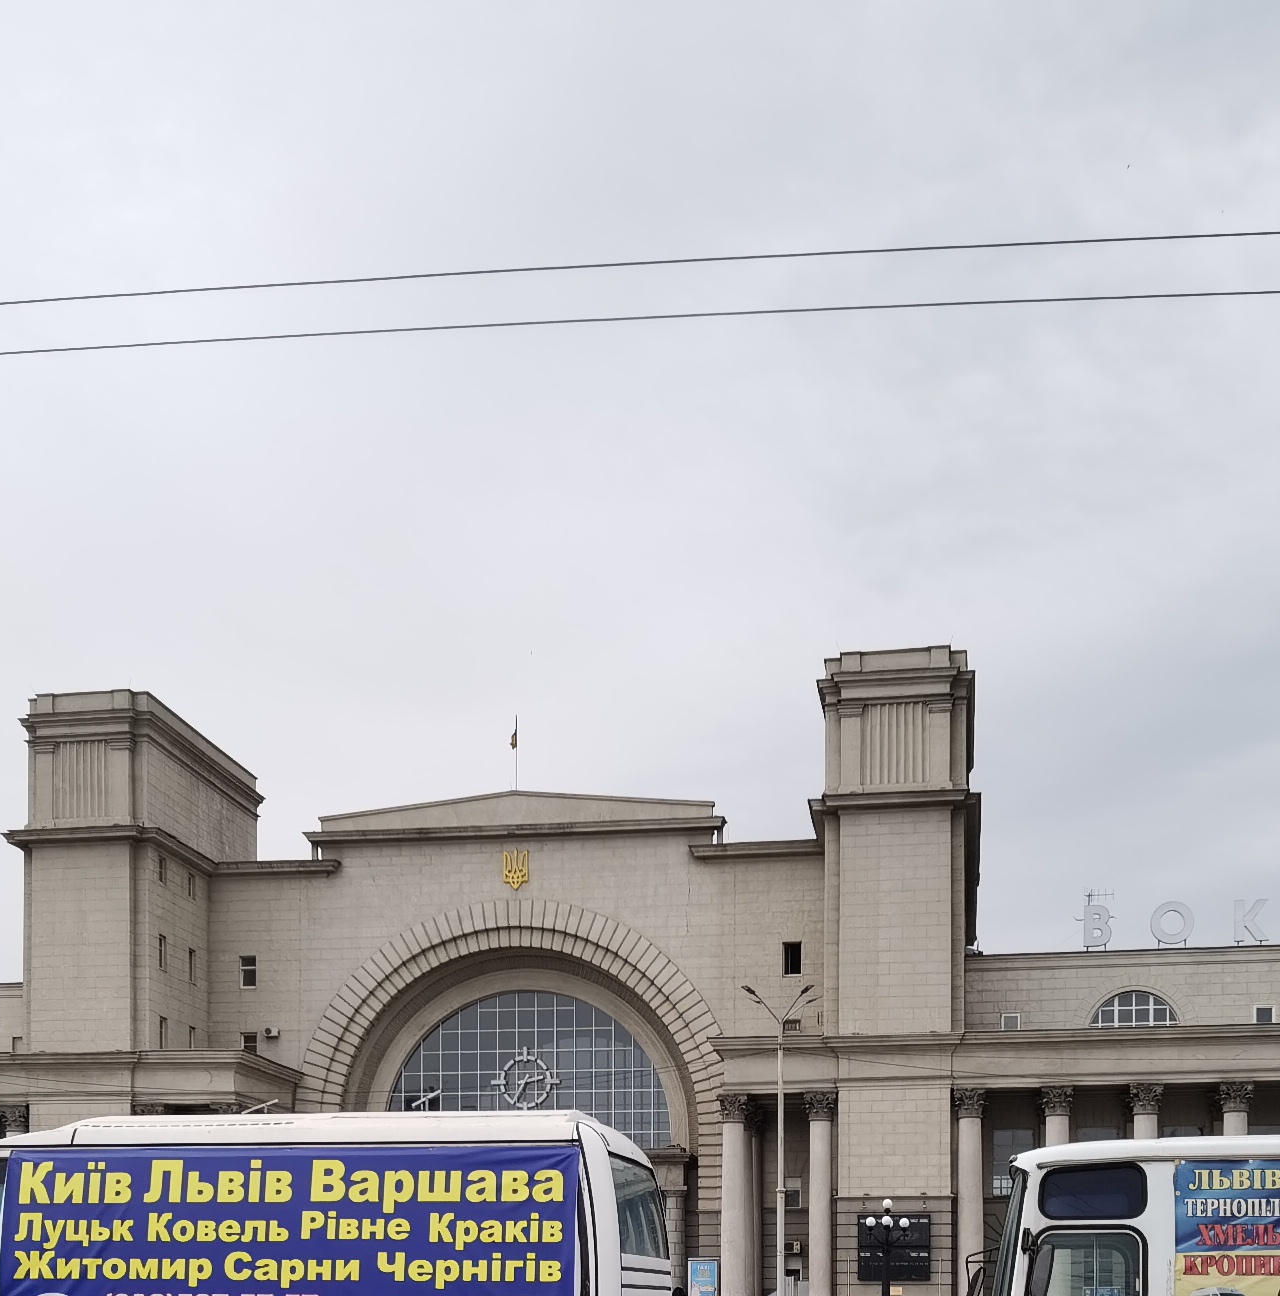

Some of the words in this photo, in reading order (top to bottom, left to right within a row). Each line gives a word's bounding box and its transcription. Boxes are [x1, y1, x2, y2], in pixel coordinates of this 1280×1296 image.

[18, 1161, 132, 1204] Київ
[143, 1159, 293, 1203] Львів
[310, 1159, 565, 1214] Варшава
[14, 1212, 134, 1250] Луцьк
[147, 1212, 290, 1243] Ковель
[300, 1210, 411, 1240] Рівне
[428, 1212, 563, 1250] Краків
[13, 1250, 213, 1288] Житомир
[224, 1251, 360, 1289] Сарни
[377, 1252, 562, 1290] Чернігів
